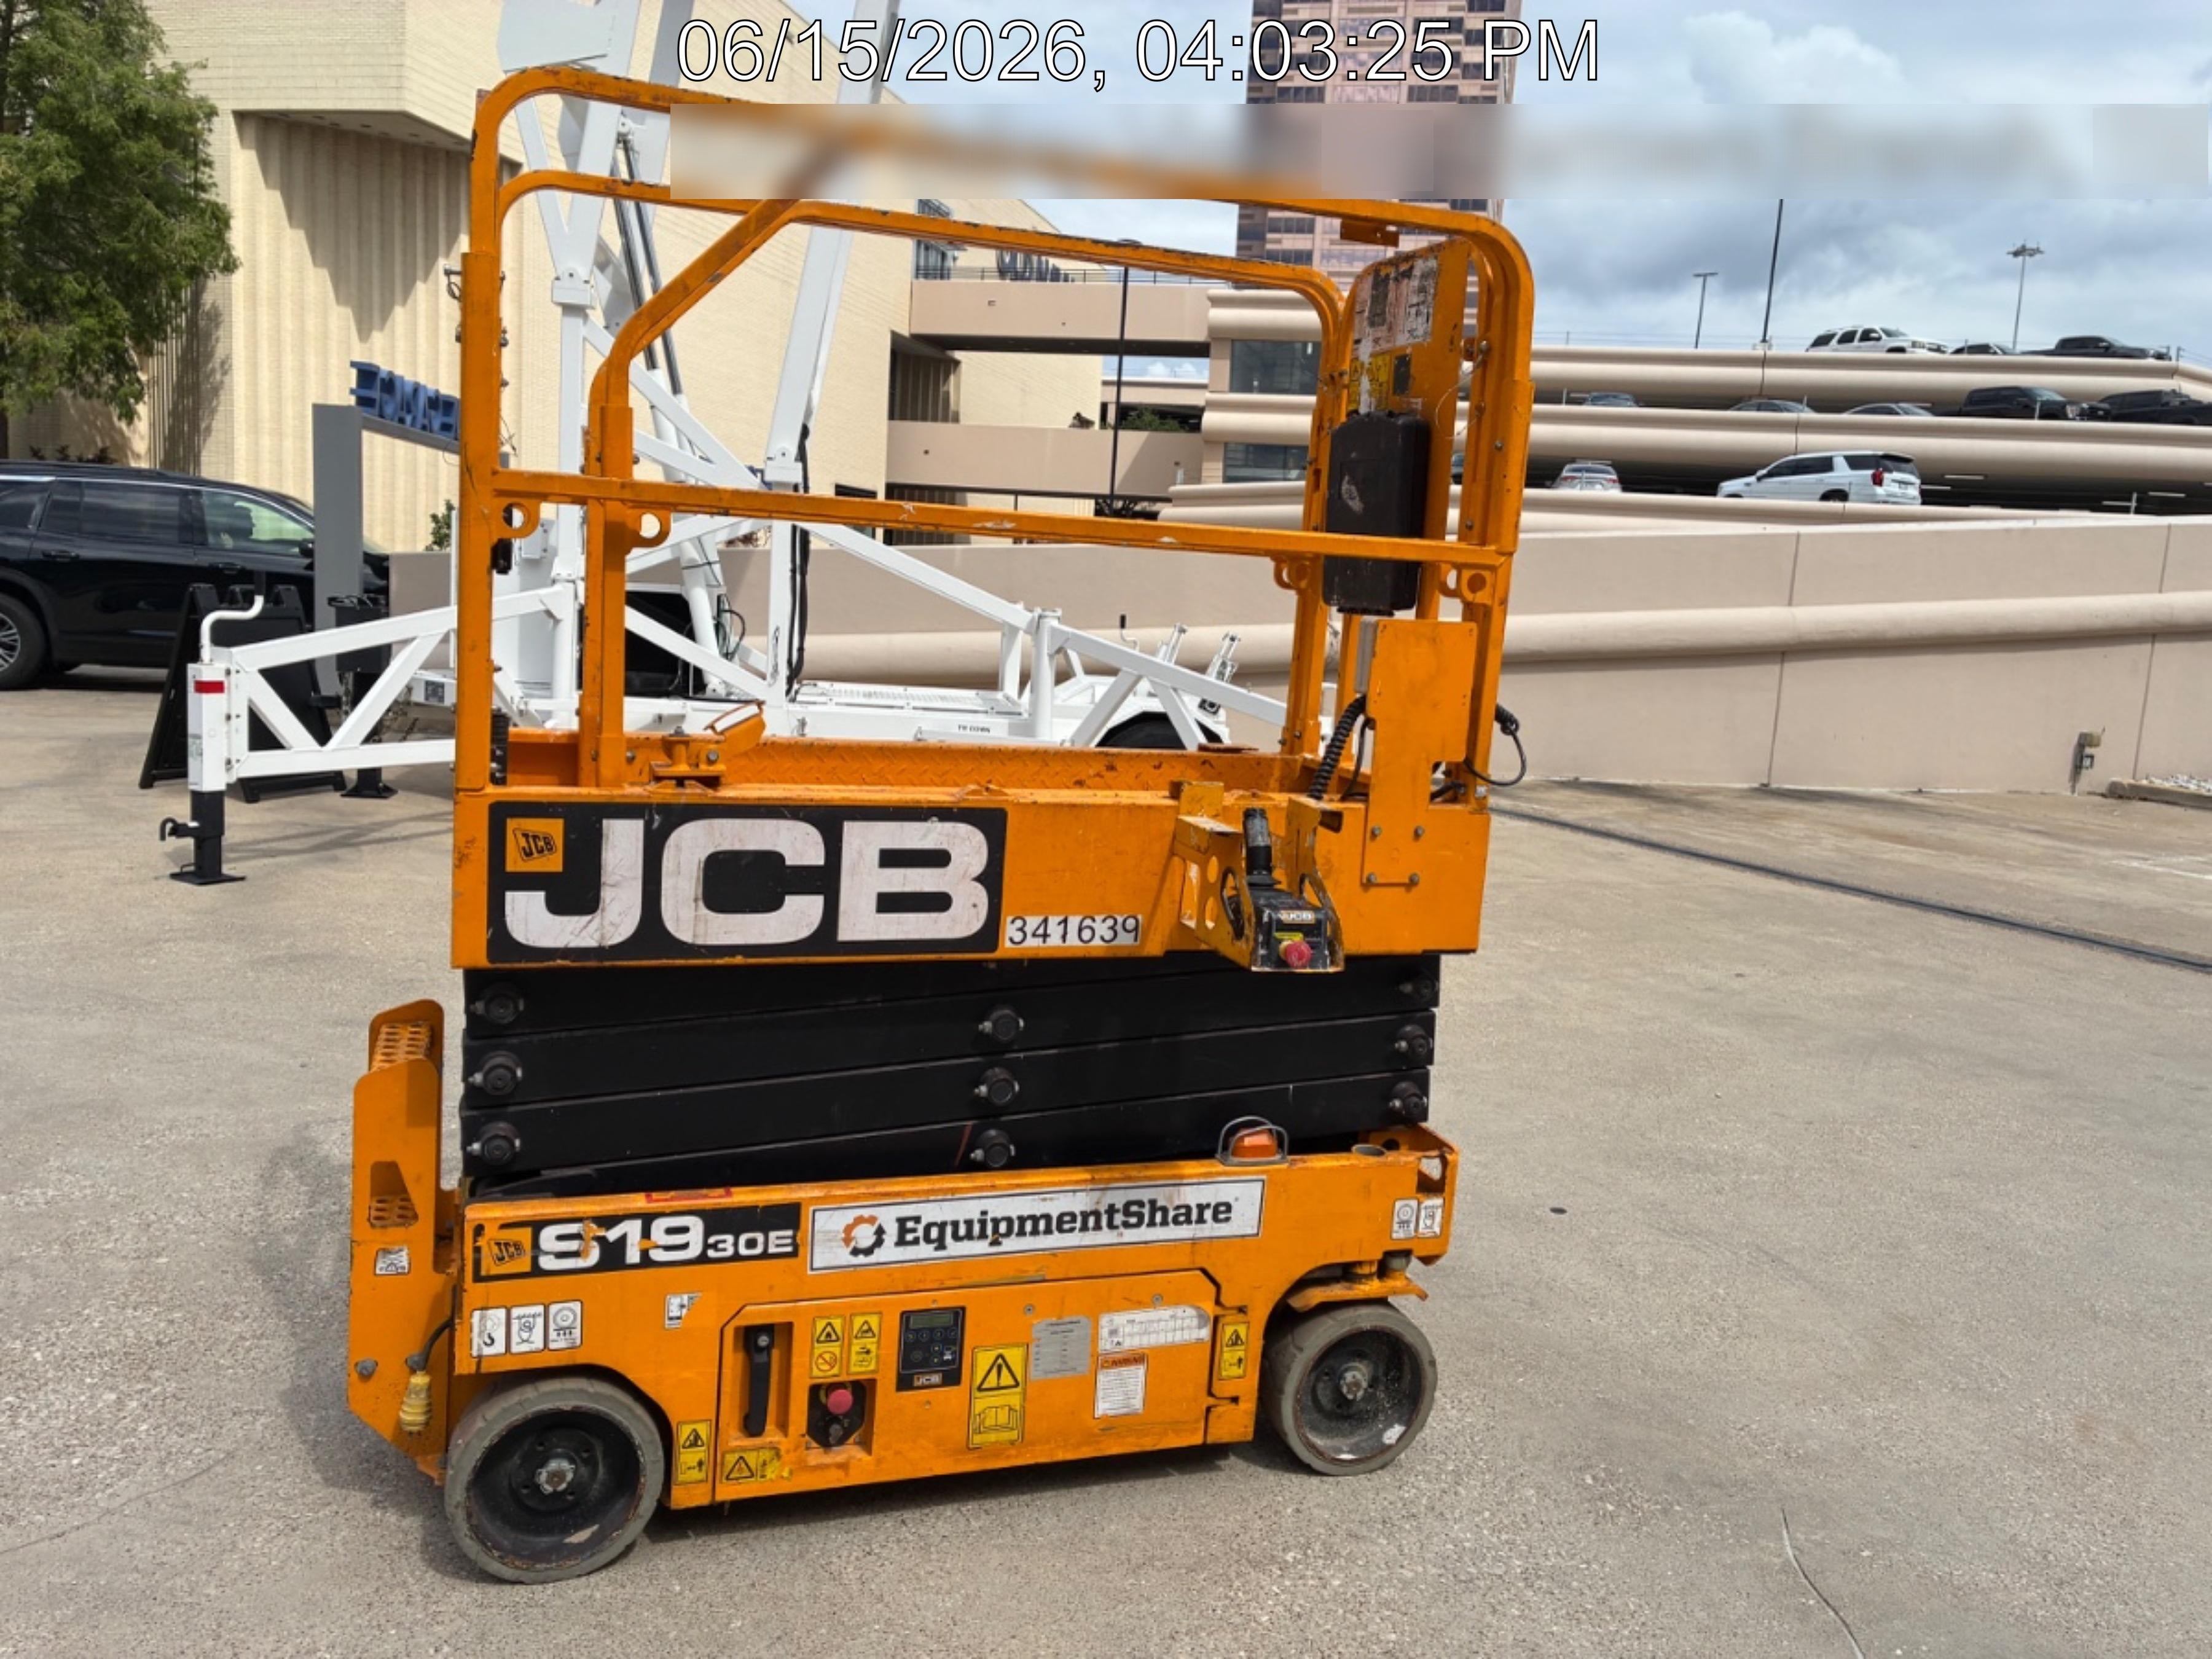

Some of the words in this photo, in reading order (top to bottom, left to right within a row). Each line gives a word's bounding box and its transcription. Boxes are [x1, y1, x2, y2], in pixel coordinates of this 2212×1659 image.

[520, 832, 554, 858] JCB
[504, 817, 989, 948] JCB
[1008, 915, 1140, 945] 341639
[894, 1198, 1233, 1250] EquipmentShare
[494, 1239, 527, 1262] JCB
